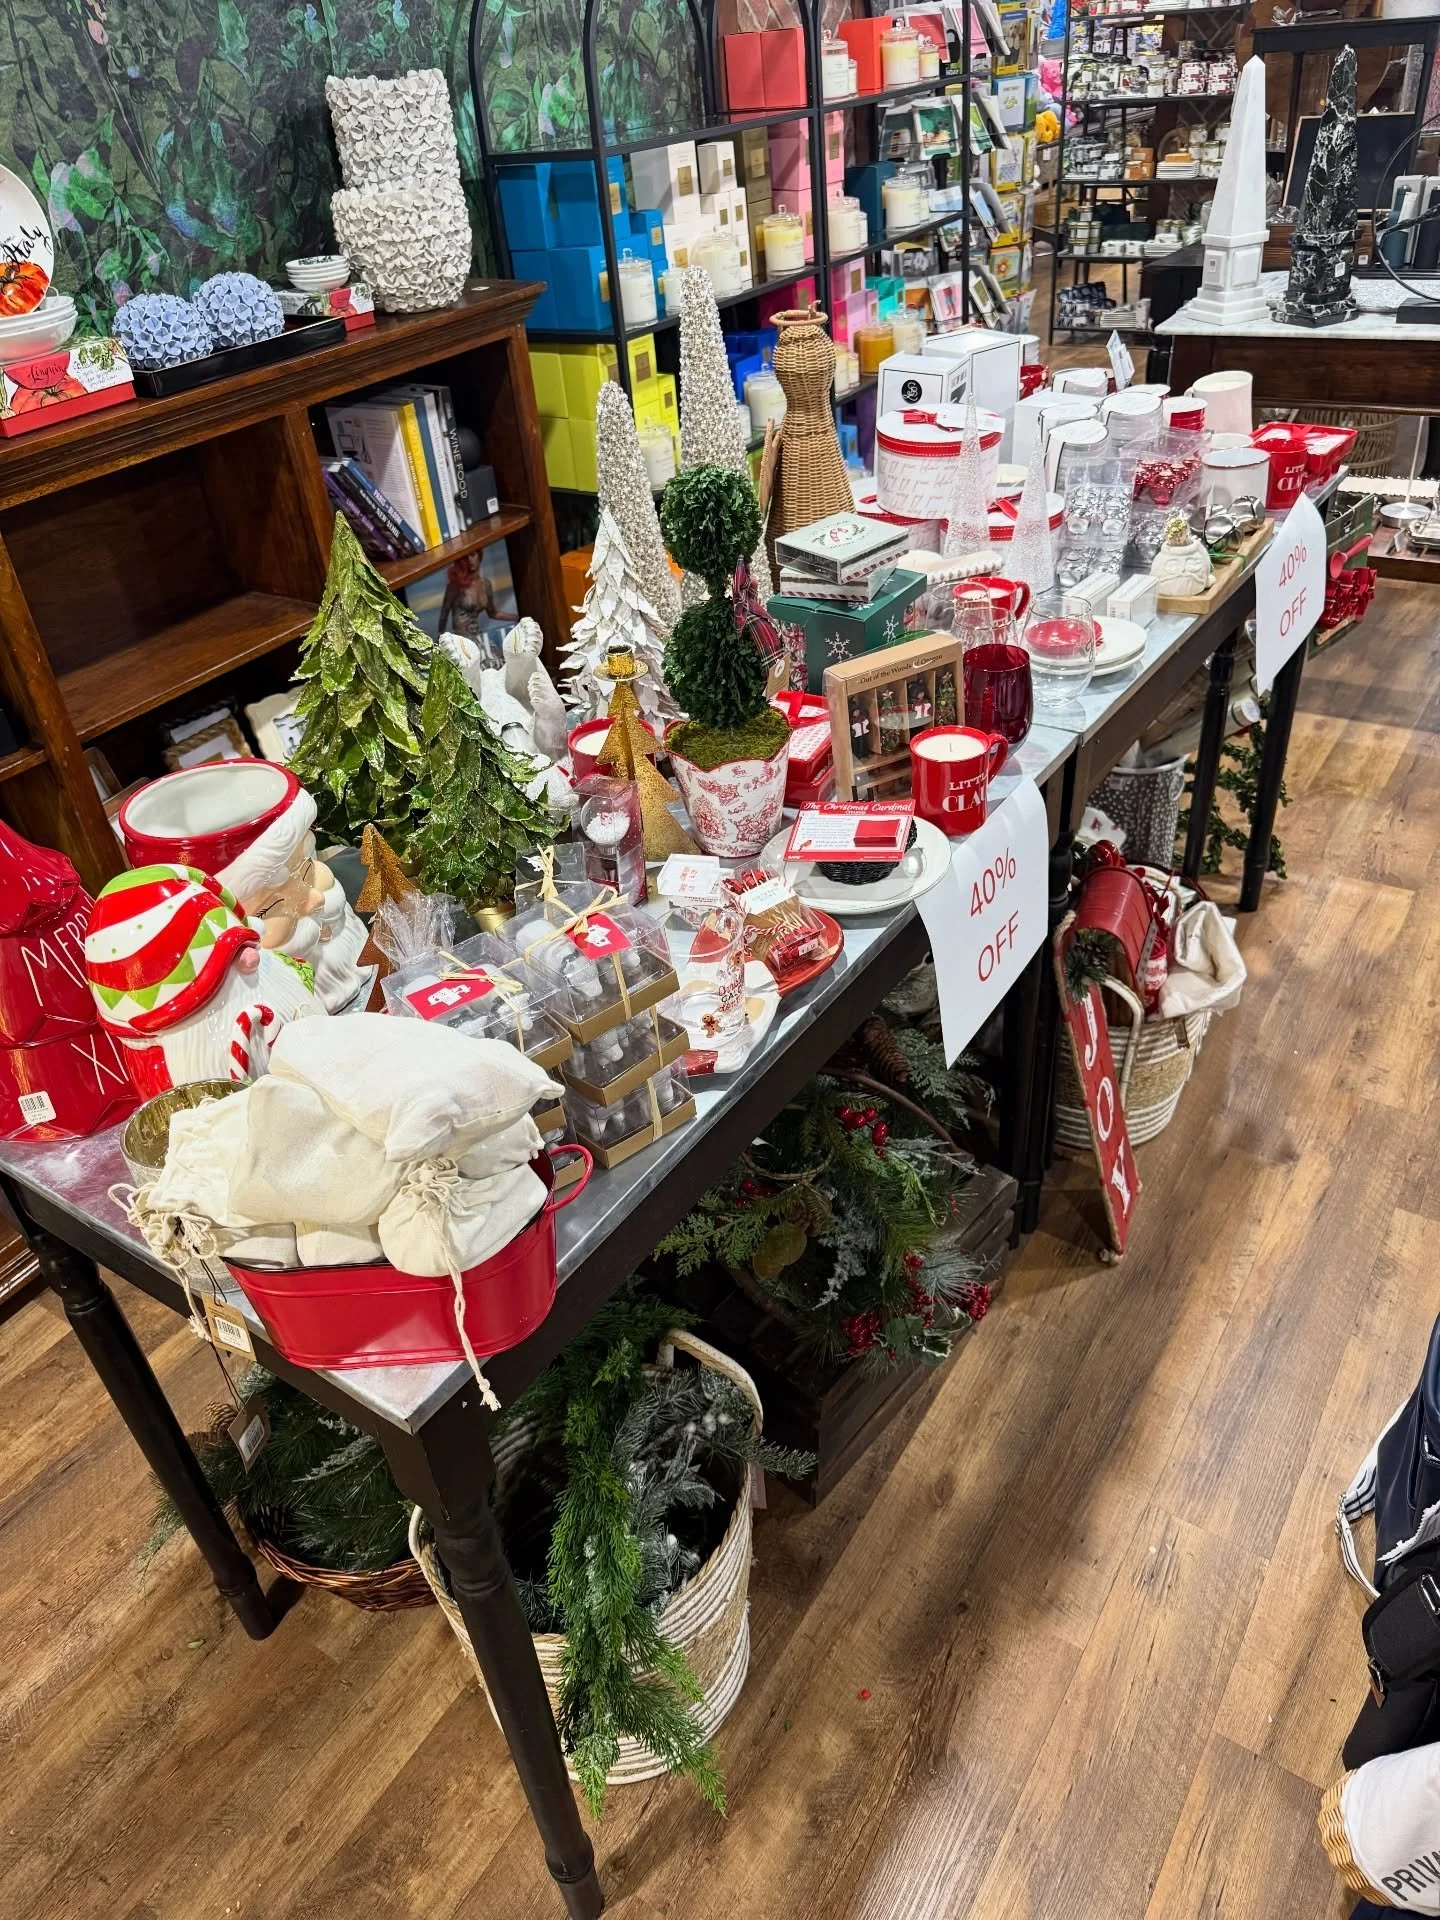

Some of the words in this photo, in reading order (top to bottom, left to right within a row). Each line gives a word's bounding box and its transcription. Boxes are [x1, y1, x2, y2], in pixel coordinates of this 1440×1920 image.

[449, 428, 461, 462] WINE
[454, 462, 468, 499] FOOD
[1279, 538, 1307, 587] 40%
[1279, 587, 1307, 637] OFF
[859, 676, 873, 684] Out
[873, 672, 880, 682] of
[880, 668, 891, 678] the
[891, 663, 912, 675] Woods
[920, 653, 943, 665] Oregon
[804, 802, 821, 811] The
[824, 802, 868, 811] Christmas
[872, 802, 912, 812] Cardinal
[970, 848, 1016, 918] 40%
[978, 910, 1019, 982] OFF
[1084, 990, 1131, 1218] JOY
